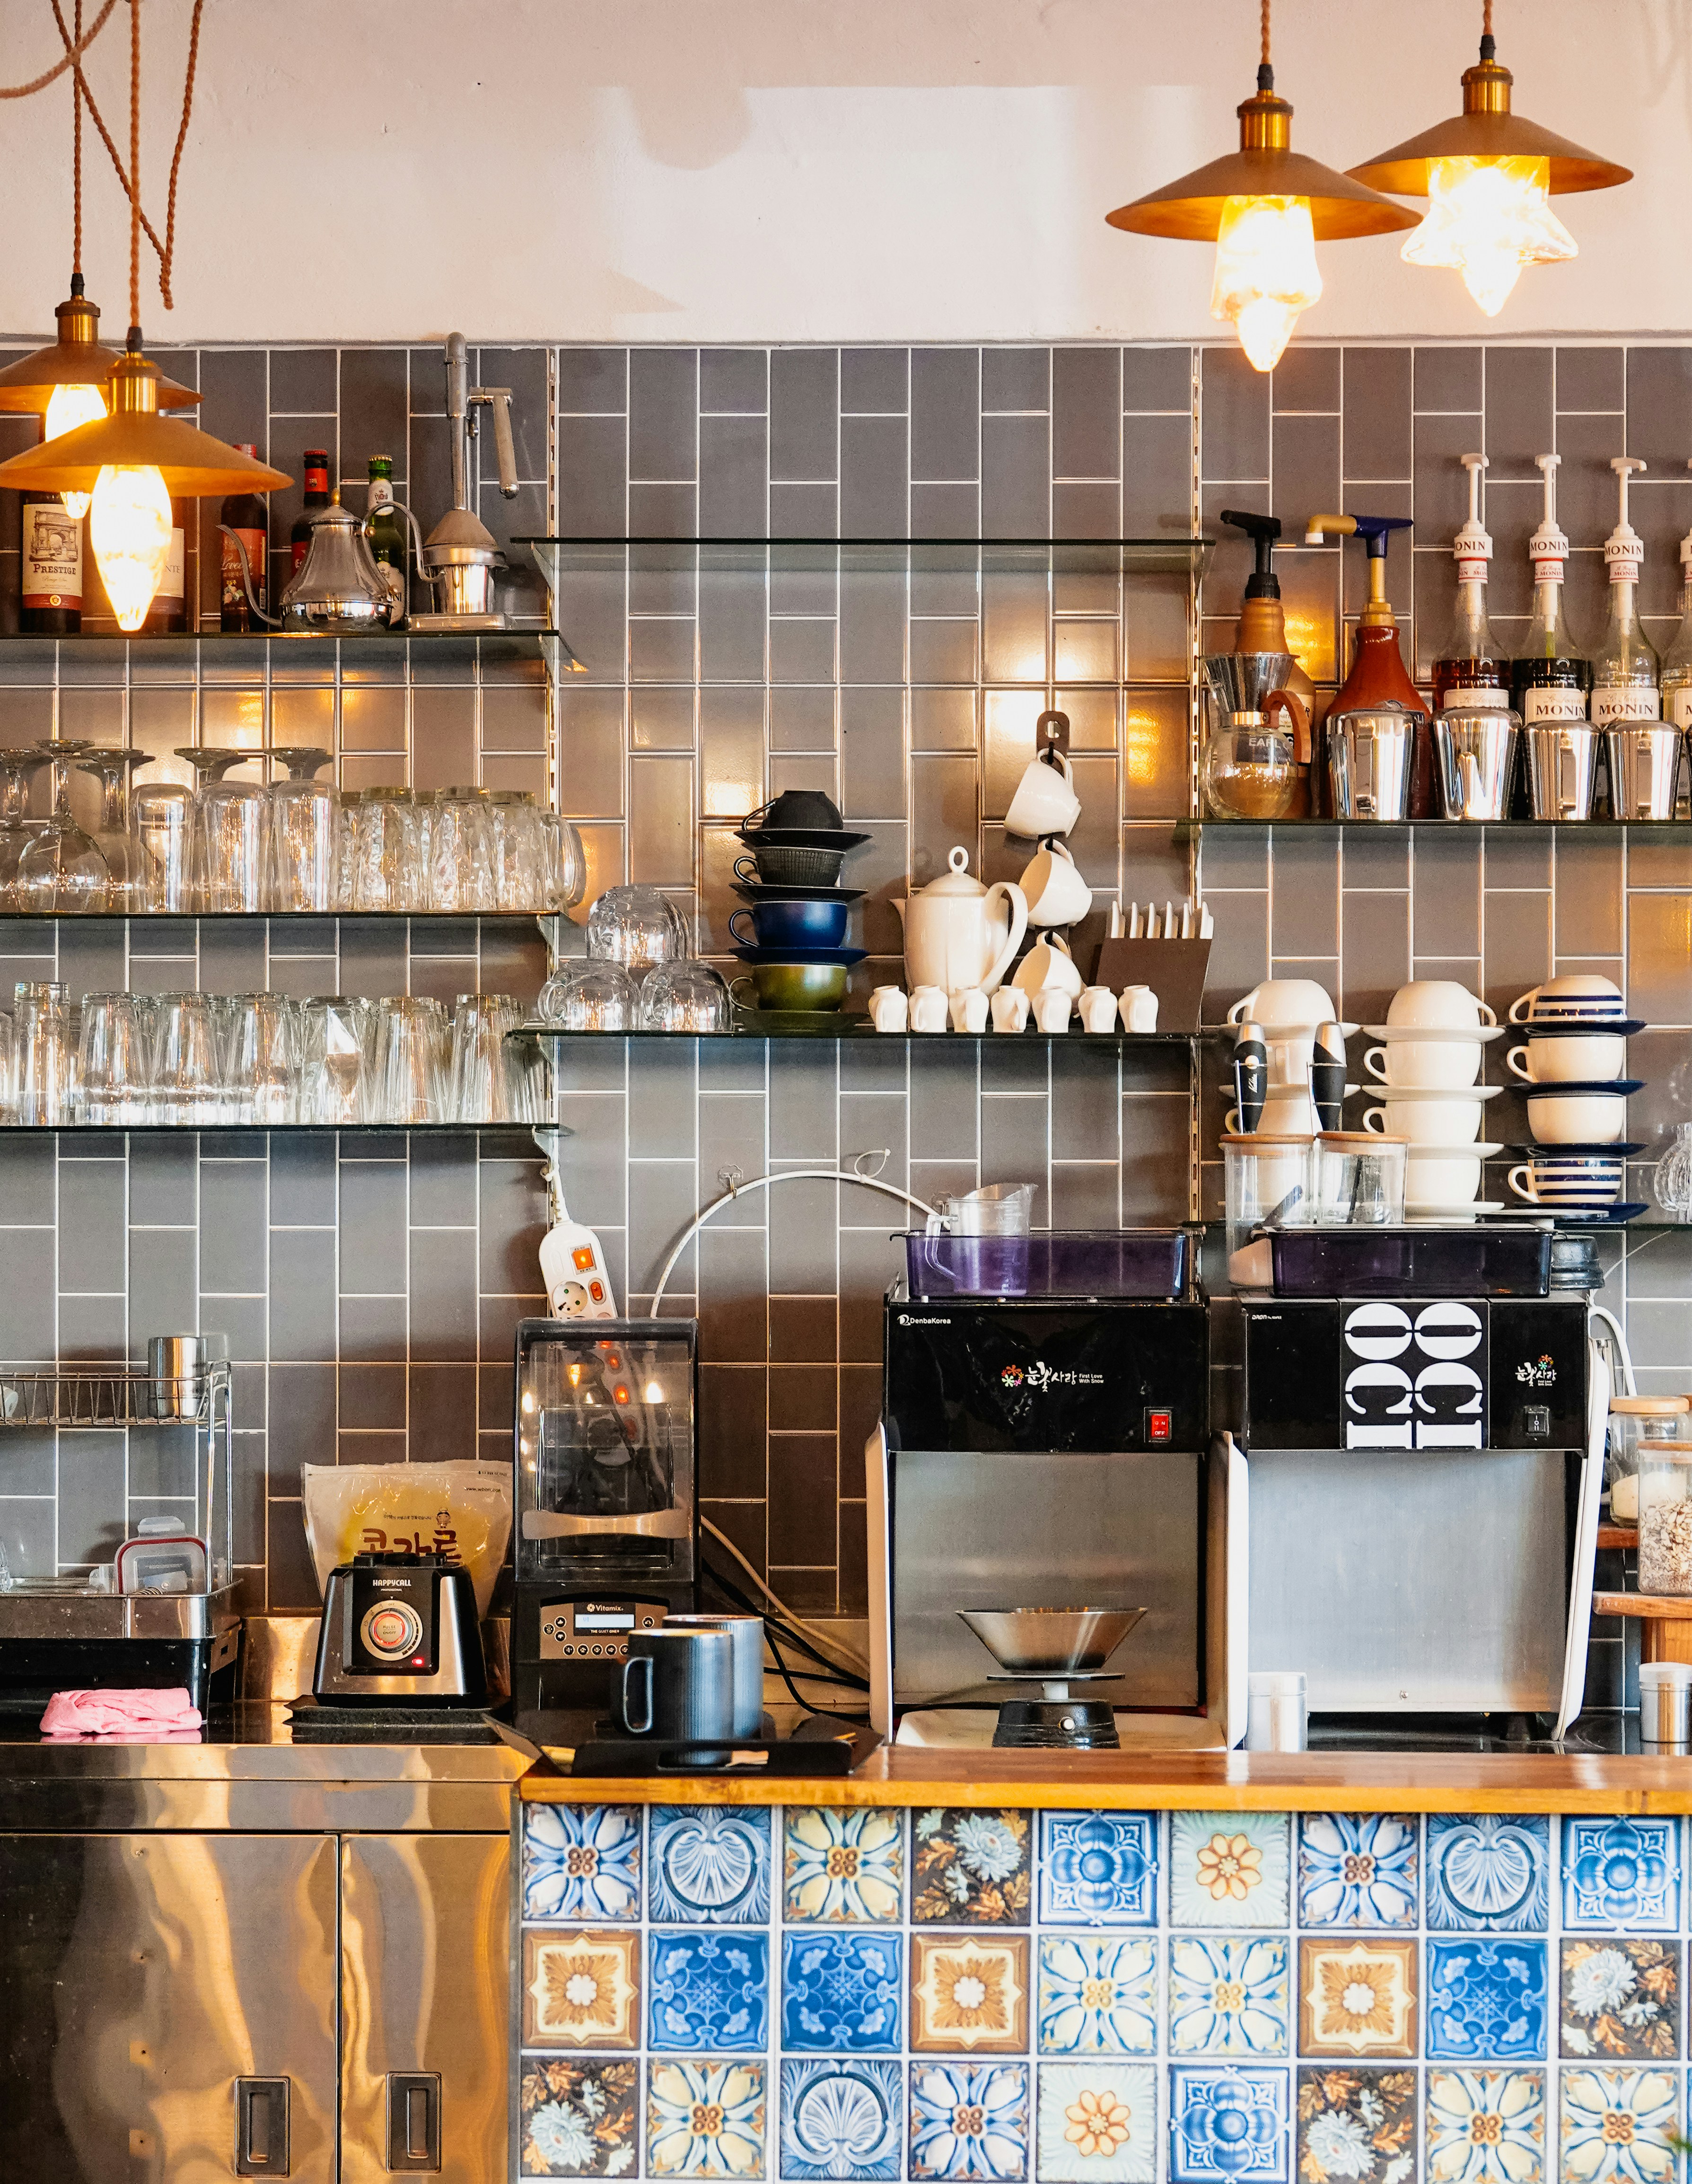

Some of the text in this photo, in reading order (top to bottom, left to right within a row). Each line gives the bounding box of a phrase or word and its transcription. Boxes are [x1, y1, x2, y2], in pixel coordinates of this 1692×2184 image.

[1455, 541, 1485, 551] ONIN
[1531, 541, 1567, 551] MONIN
[1605, 545, 1641, 555] MONIN
[33, 563, 76, 575] PRESTIGE
[1536, 704, 1584, 716] MONIN
[1599, 704, 1653, 715] MONIN
